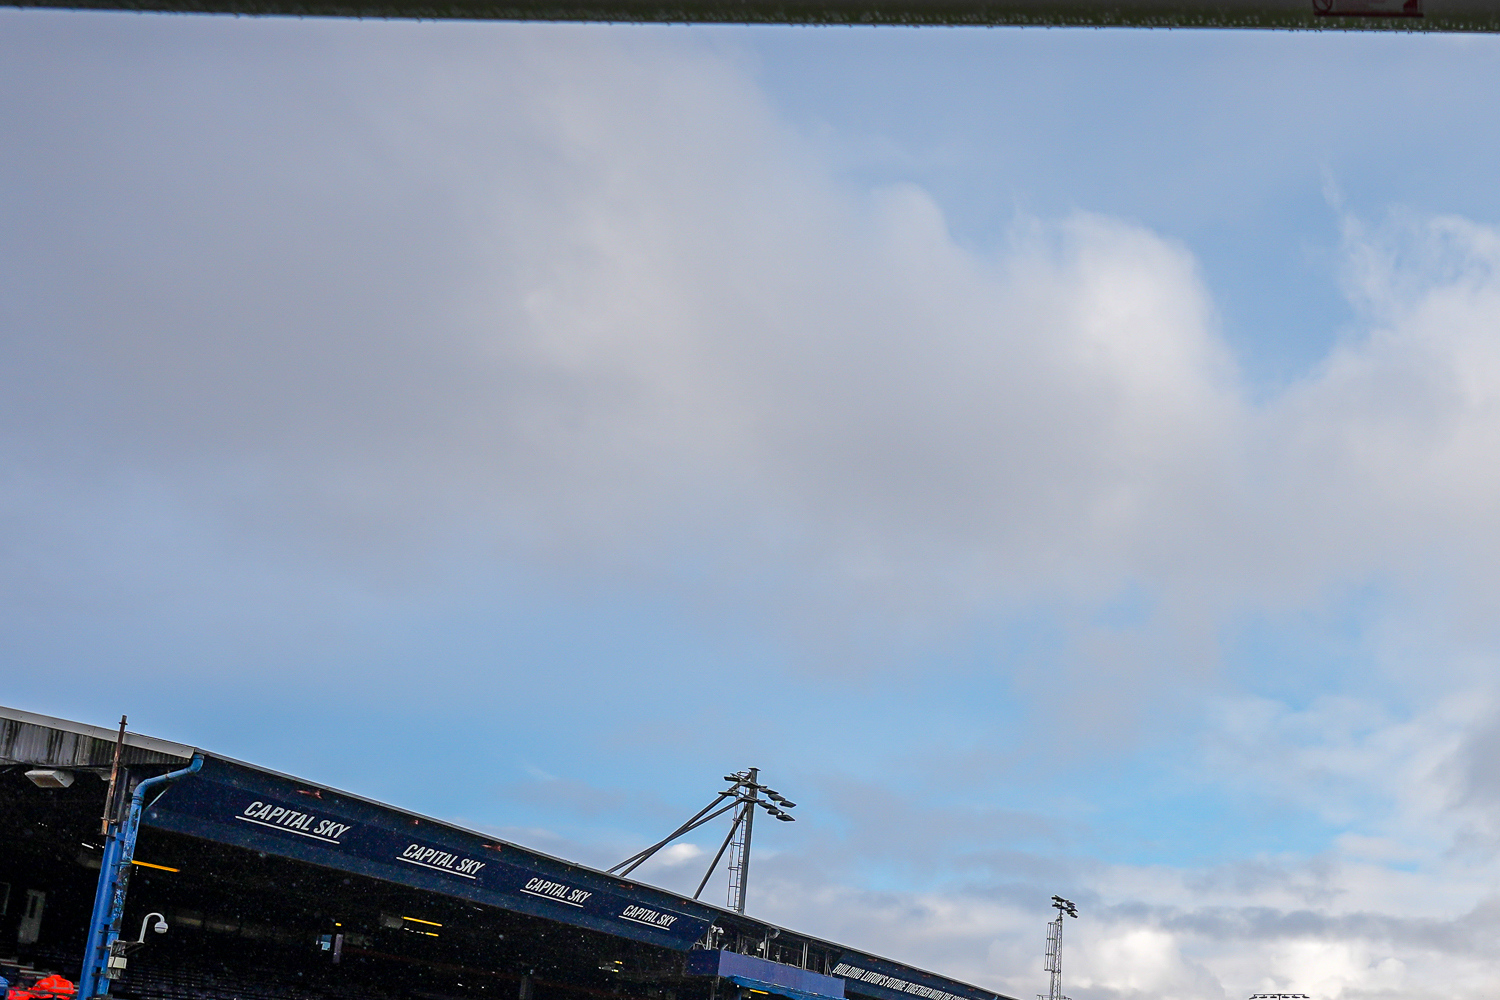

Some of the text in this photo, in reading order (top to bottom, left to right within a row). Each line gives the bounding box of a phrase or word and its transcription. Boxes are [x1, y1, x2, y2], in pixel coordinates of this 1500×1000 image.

[244, 801, 351, 839] CAPITAL SKY
[402, 844, 486, 875] CAPITAL SKY
[524, 877, 592, 904] CAPITAL SKY
[622, 904, 678, 927] CAPITAL SKY
[832, 962, 865, 980] BUILDING
[904, 982, 932, 998] TOGETHER
